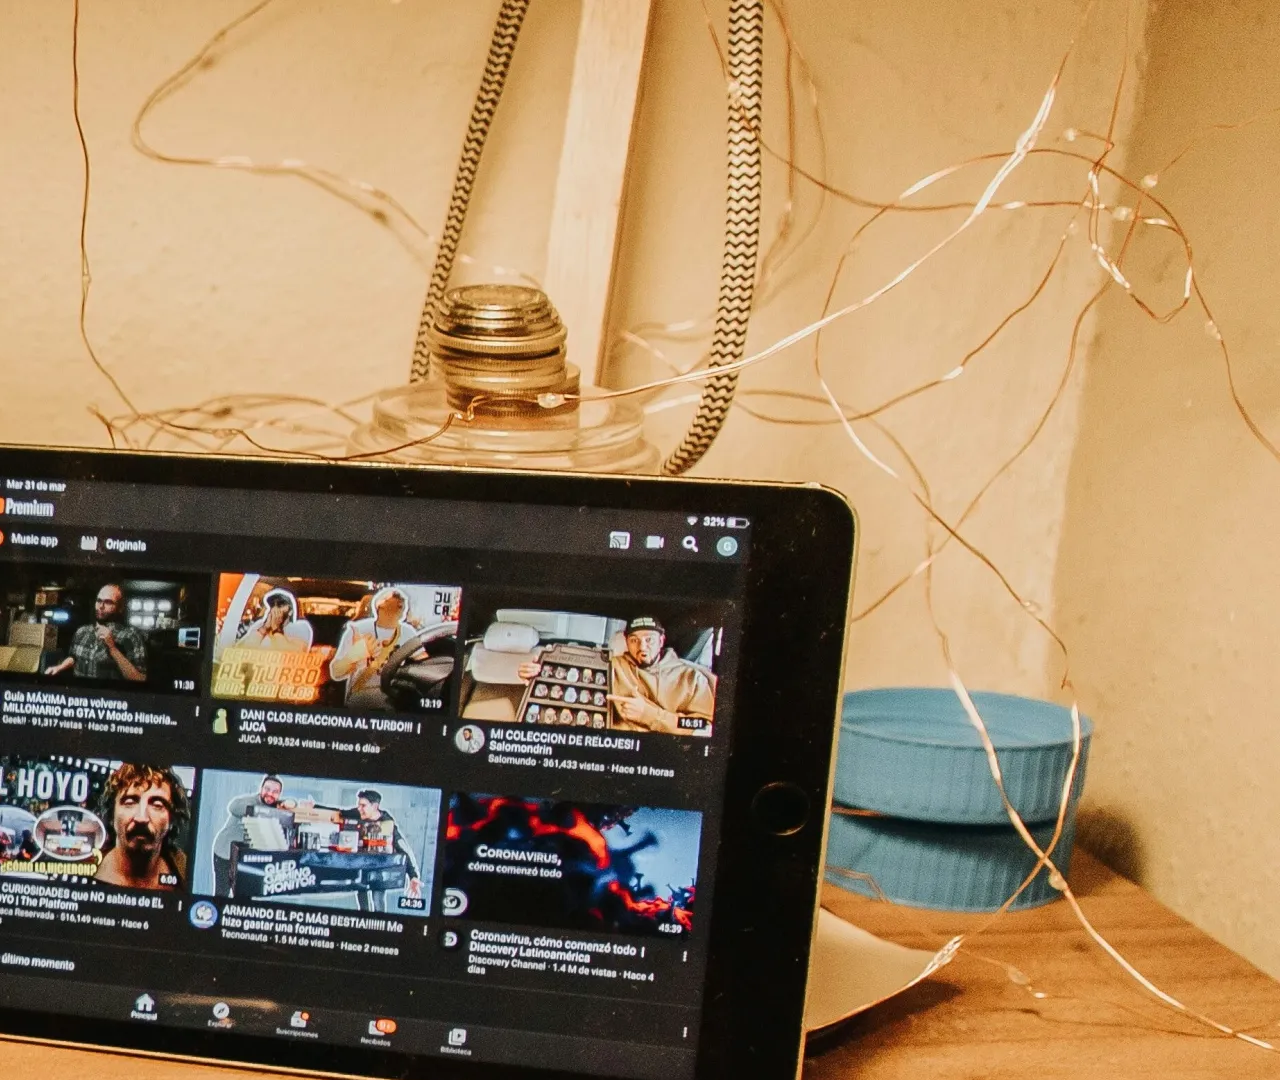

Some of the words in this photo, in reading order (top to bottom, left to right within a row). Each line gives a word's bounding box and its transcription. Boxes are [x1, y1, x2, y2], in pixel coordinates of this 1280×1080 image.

[5, 497, 54, 517] Premium
[10, 532, 40, 546] Music
[40, 535, 59, 548] app
[106, 538, 147, 553] Originals
[3, 701, 61, 717] MILLONARIO
[76, 708, 96, 720] GTA
[106, 710, 133, 723] Modo
[240, 708, 265, 722] DANI
[267, 711, 294, 724] CLOS
[295, 713, 354, 730] REACCIONA
[355, 718, 369, 731] AL
[239, 721, 267, 734] JUCA
[488, 740, 553, 756] Salomondrin
[490, 728, 504, 741] MI
[505, 730, 566, 746] COLECCION
[568, 734, 583, 747] DE
[584, 736, 634, 751] RELOJES!
[16, 766, 89, 803] HOYO
[476, 845, 563, 866] CORONAVIRUS,
[467, 860, 494, 873] cómo
[495, 863, 539, 877] comenzó
[539, 867, 563, 879] todo
[223, 904, 275, 922] ARMANDO
[275, 909, 288, 922] EL
[289, 911, 303, 923] PC
[304, 910, 329, 926] MÁS
[221, 916, 242, 929] hizo
[243, 918, 274, 932] gastar
[294, 922, 330, 937] fortuna
[221, 930, 268, 943] Tecnonauta
[469, 941, 518, 958] Discovery
[519, 946, 591, 964] Latinoamérica
[470, 929, 532, 947] Coronavirus,
[533, 935, 563, 949] cómo
[564, 939, 611, 955] comenzó
[612, 944, 637, 957] todo
[1, 953, 30, 967] último
[31, 957, 75, 972] momento
[468, 954, 510, 969] Discovery
[511, 959, 546, 972] Channel
